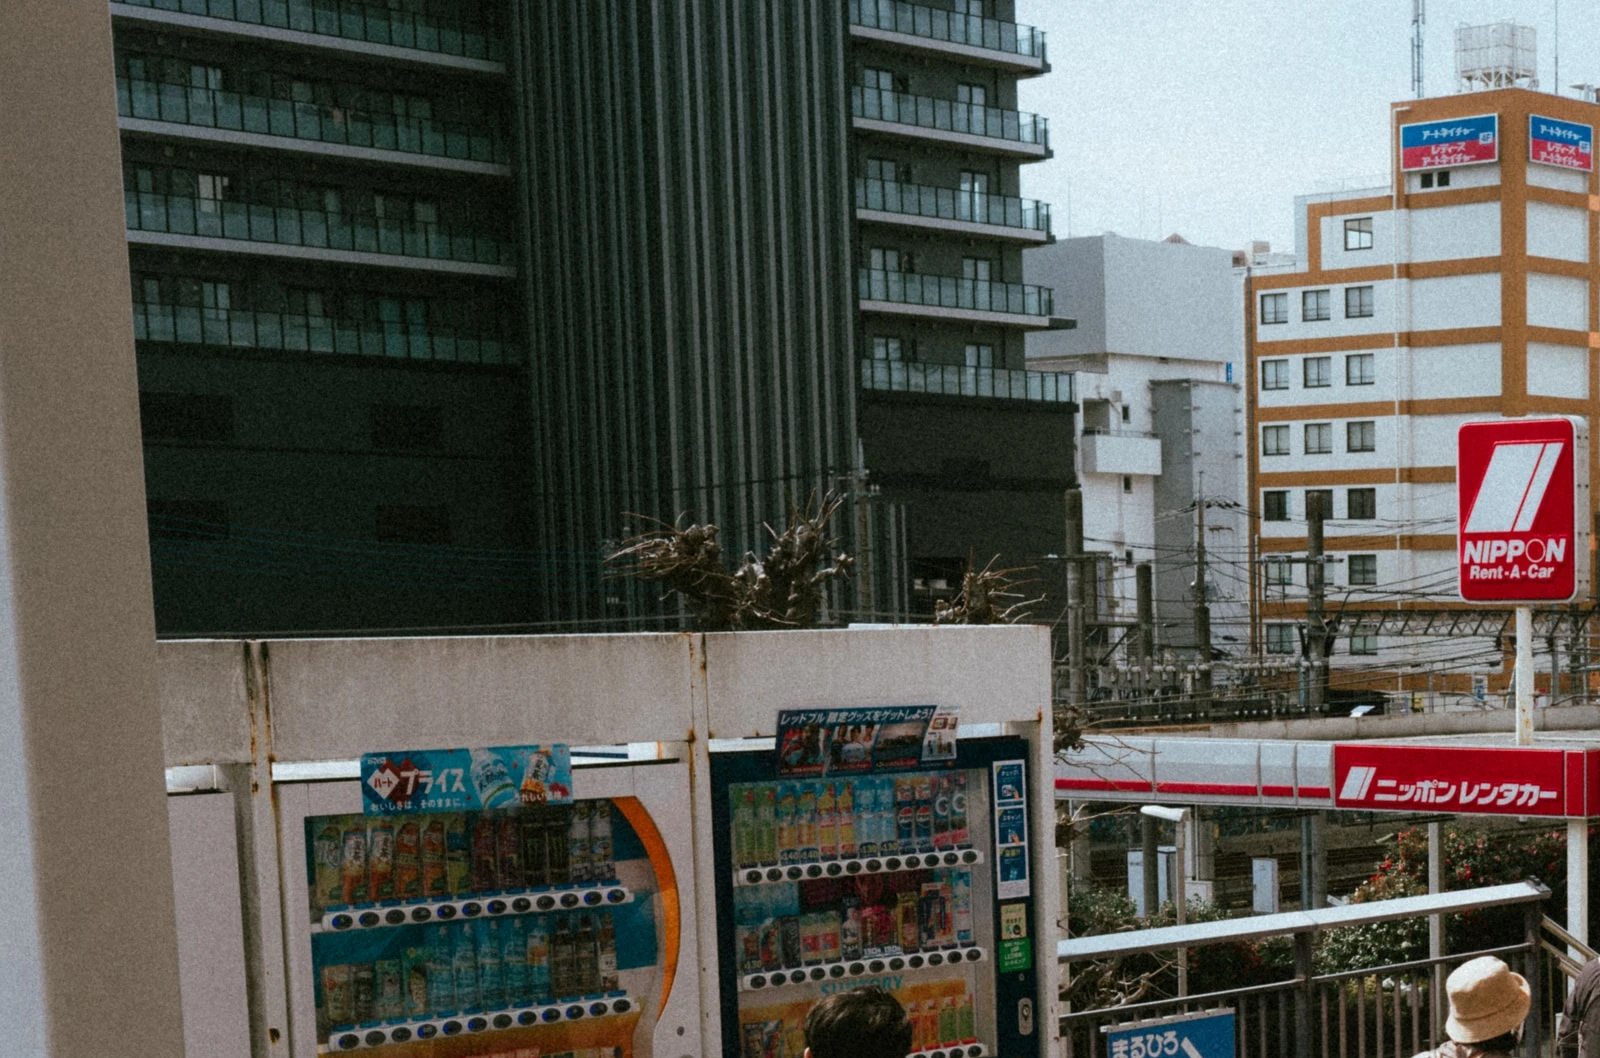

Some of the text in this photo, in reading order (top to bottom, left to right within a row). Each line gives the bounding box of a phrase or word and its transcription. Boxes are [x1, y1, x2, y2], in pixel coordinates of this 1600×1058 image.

[1421, 124, 1476, 141] アートネイチャー
[1431, 143, 1466, 155] レディース
[1463, 537, 1566, 564] NIPPON
[375, 768, 466, 796] ハート プライス
